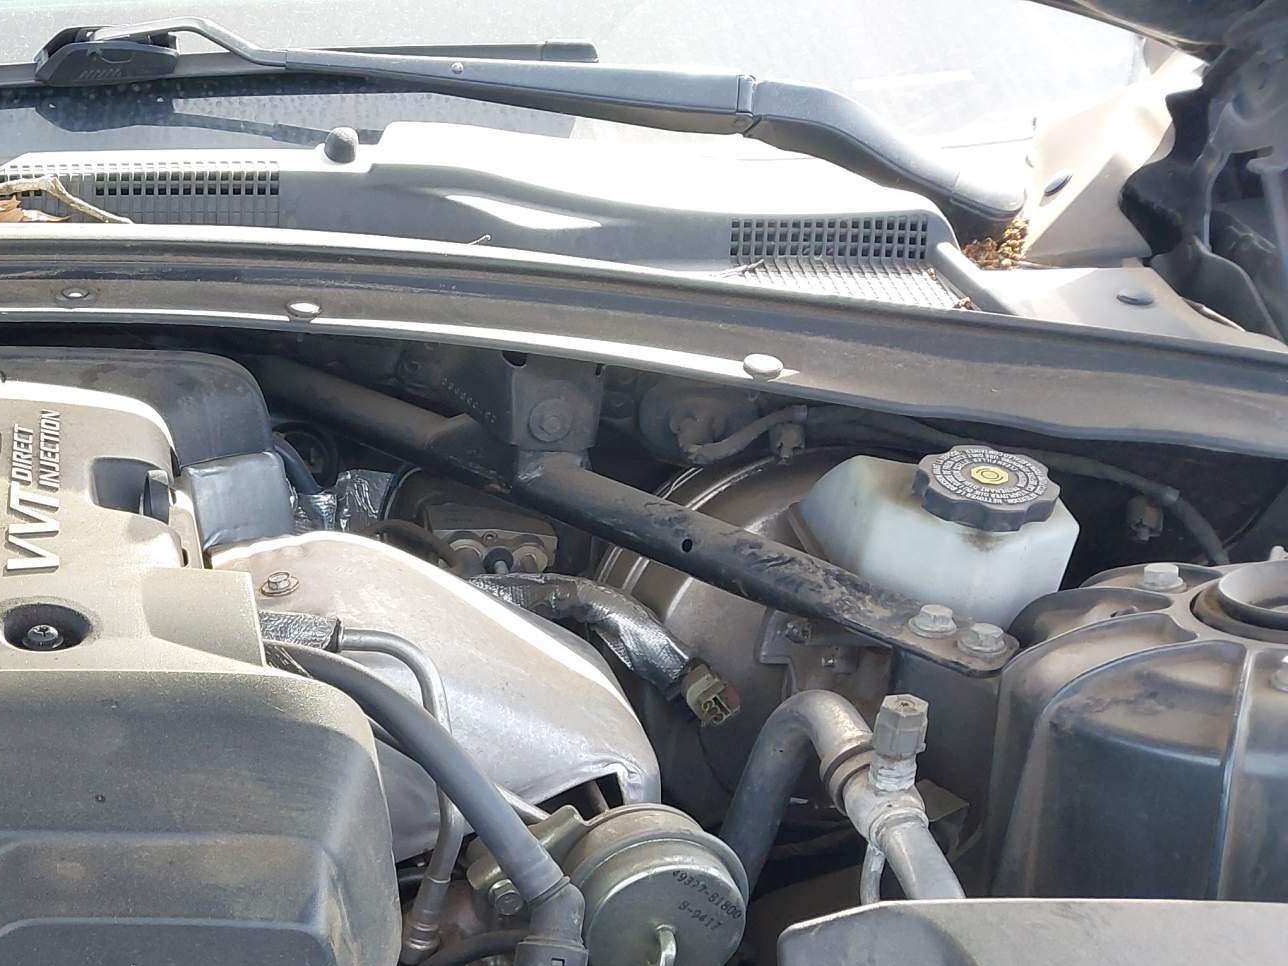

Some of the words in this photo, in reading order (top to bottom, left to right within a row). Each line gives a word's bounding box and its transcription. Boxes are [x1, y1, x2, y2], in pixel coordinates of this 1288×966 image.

[12, 423, 34, 482] DIRECT
[39, 408, 61, 489] INJECTION
[7, 481, 60, 570] VVT
